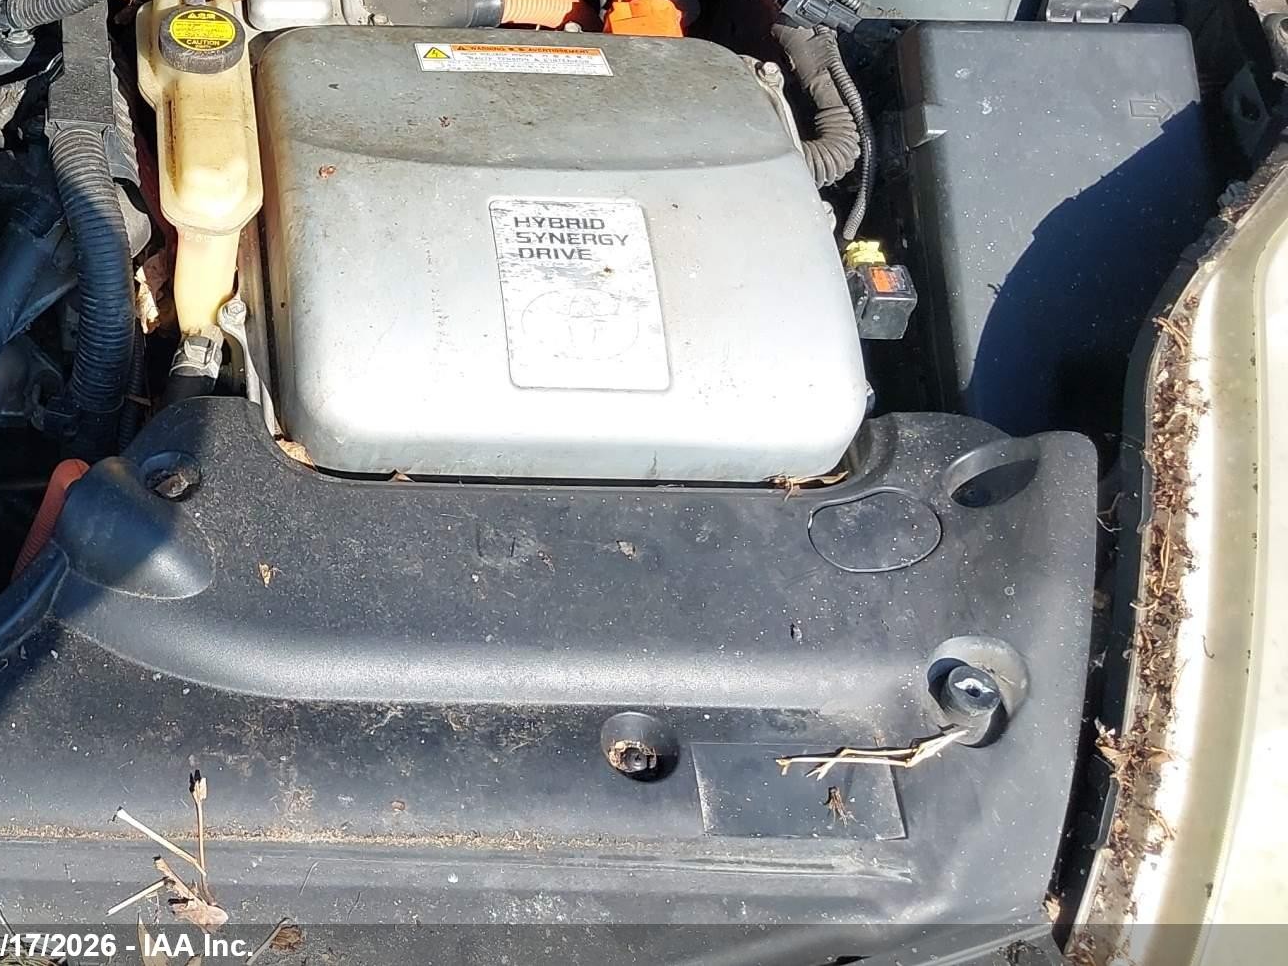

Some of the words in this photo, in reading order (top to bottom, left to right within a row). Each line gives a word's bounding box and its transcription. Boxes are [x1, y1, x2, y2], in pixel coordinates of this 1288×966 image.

[514, 216, 605, 230] HYBRID
[515, 232, 628, 246] SYNERGY
[518, 247, 592, 260] DRIVE
